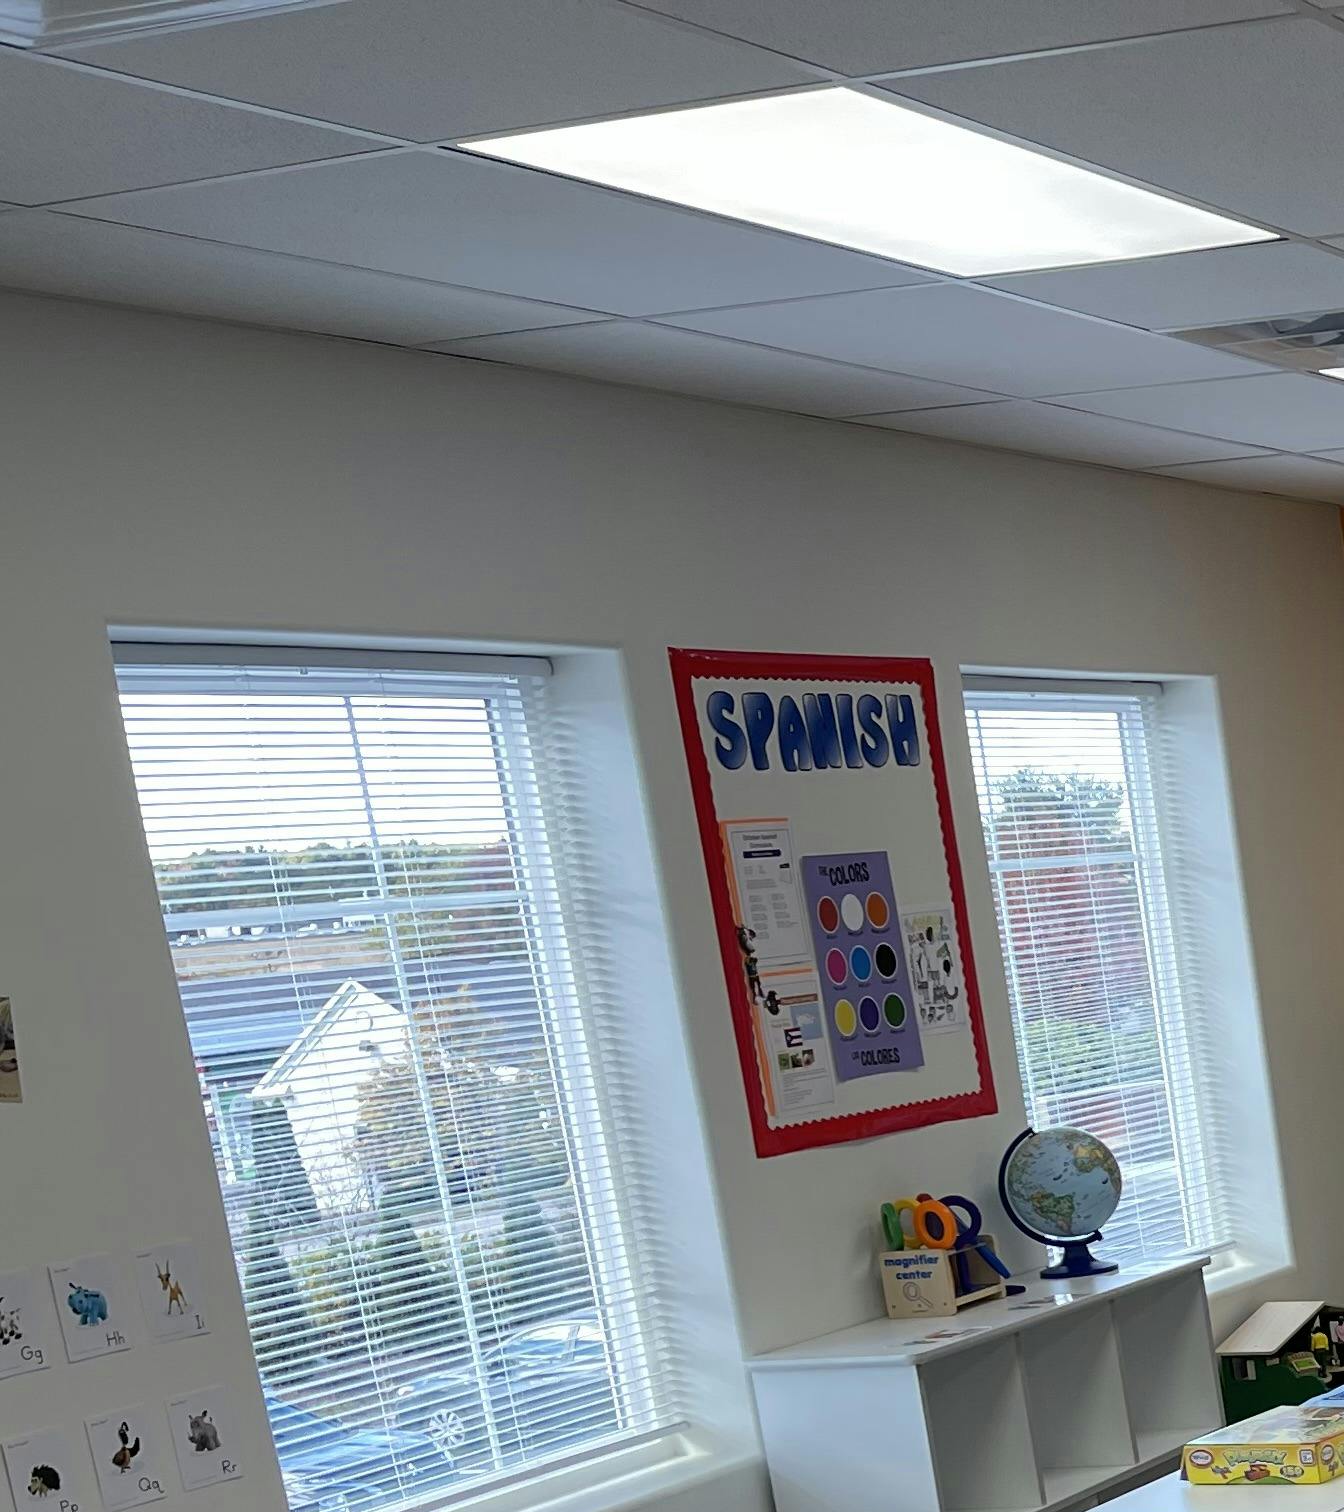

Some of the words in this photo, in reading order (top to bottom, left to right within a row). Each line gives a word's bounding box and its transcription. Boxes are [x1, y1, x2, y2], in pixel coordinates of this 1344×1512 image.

[706, 690, 920, 772] SPANISH
[828, 862, 870, 886] COLORS
[860, 1047, 900, 1066] COLORES
[884, 1254, 939, 1268] magnifier
[896, 1270, 932, 1280] center
[105, 1330, 126, 1347] Hh
[20, 1345, 44, 1365] Gg
[221, 1459, 238, 1475] Rr
[138, 1477, 165, 1494] Qq
